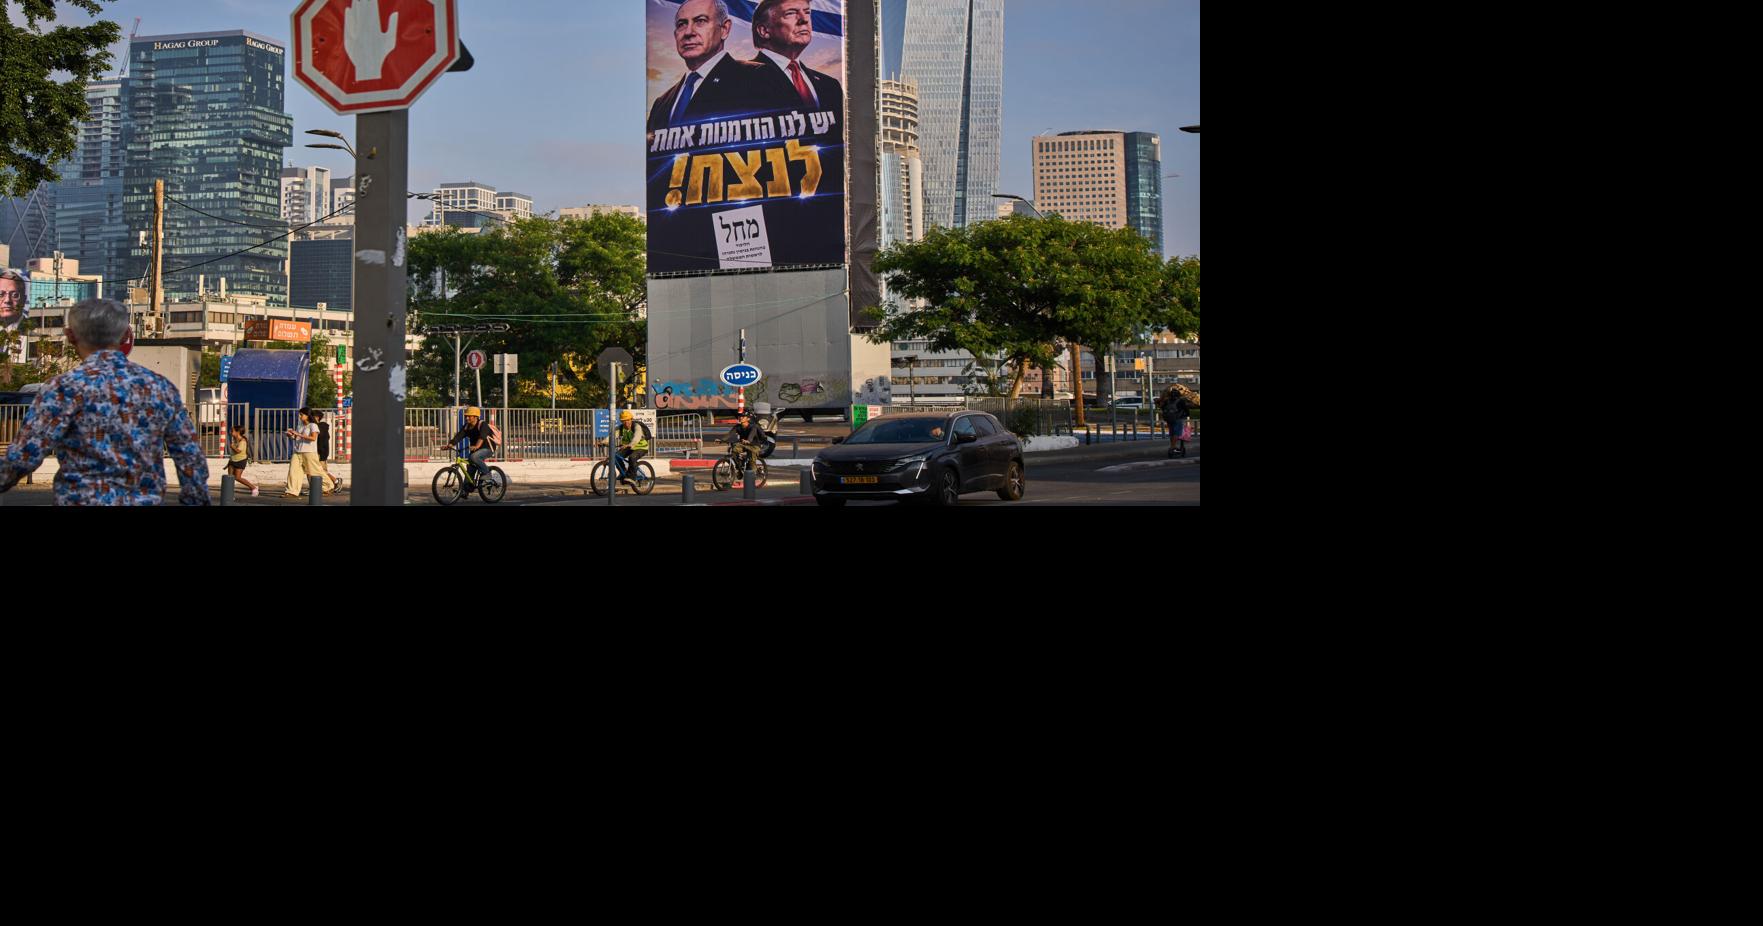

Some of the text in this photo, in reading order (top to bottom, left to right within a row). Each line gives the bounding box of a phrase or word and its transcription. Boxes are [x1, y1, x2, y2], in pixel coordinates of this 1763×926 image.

[154, 40, 219, 50] HAGAG GROUP
[246, 38, 284, 54] HAGAG GROUP
[778, 110, 806, 138] לנו
[808, 111, 836, 135] יש
[650, 125, 696, 152] אחת
[664, 139, 823, 208] לנצח!
[718, 216, 760, 244] מחל
[726, 370, 756, 380] כניסה
